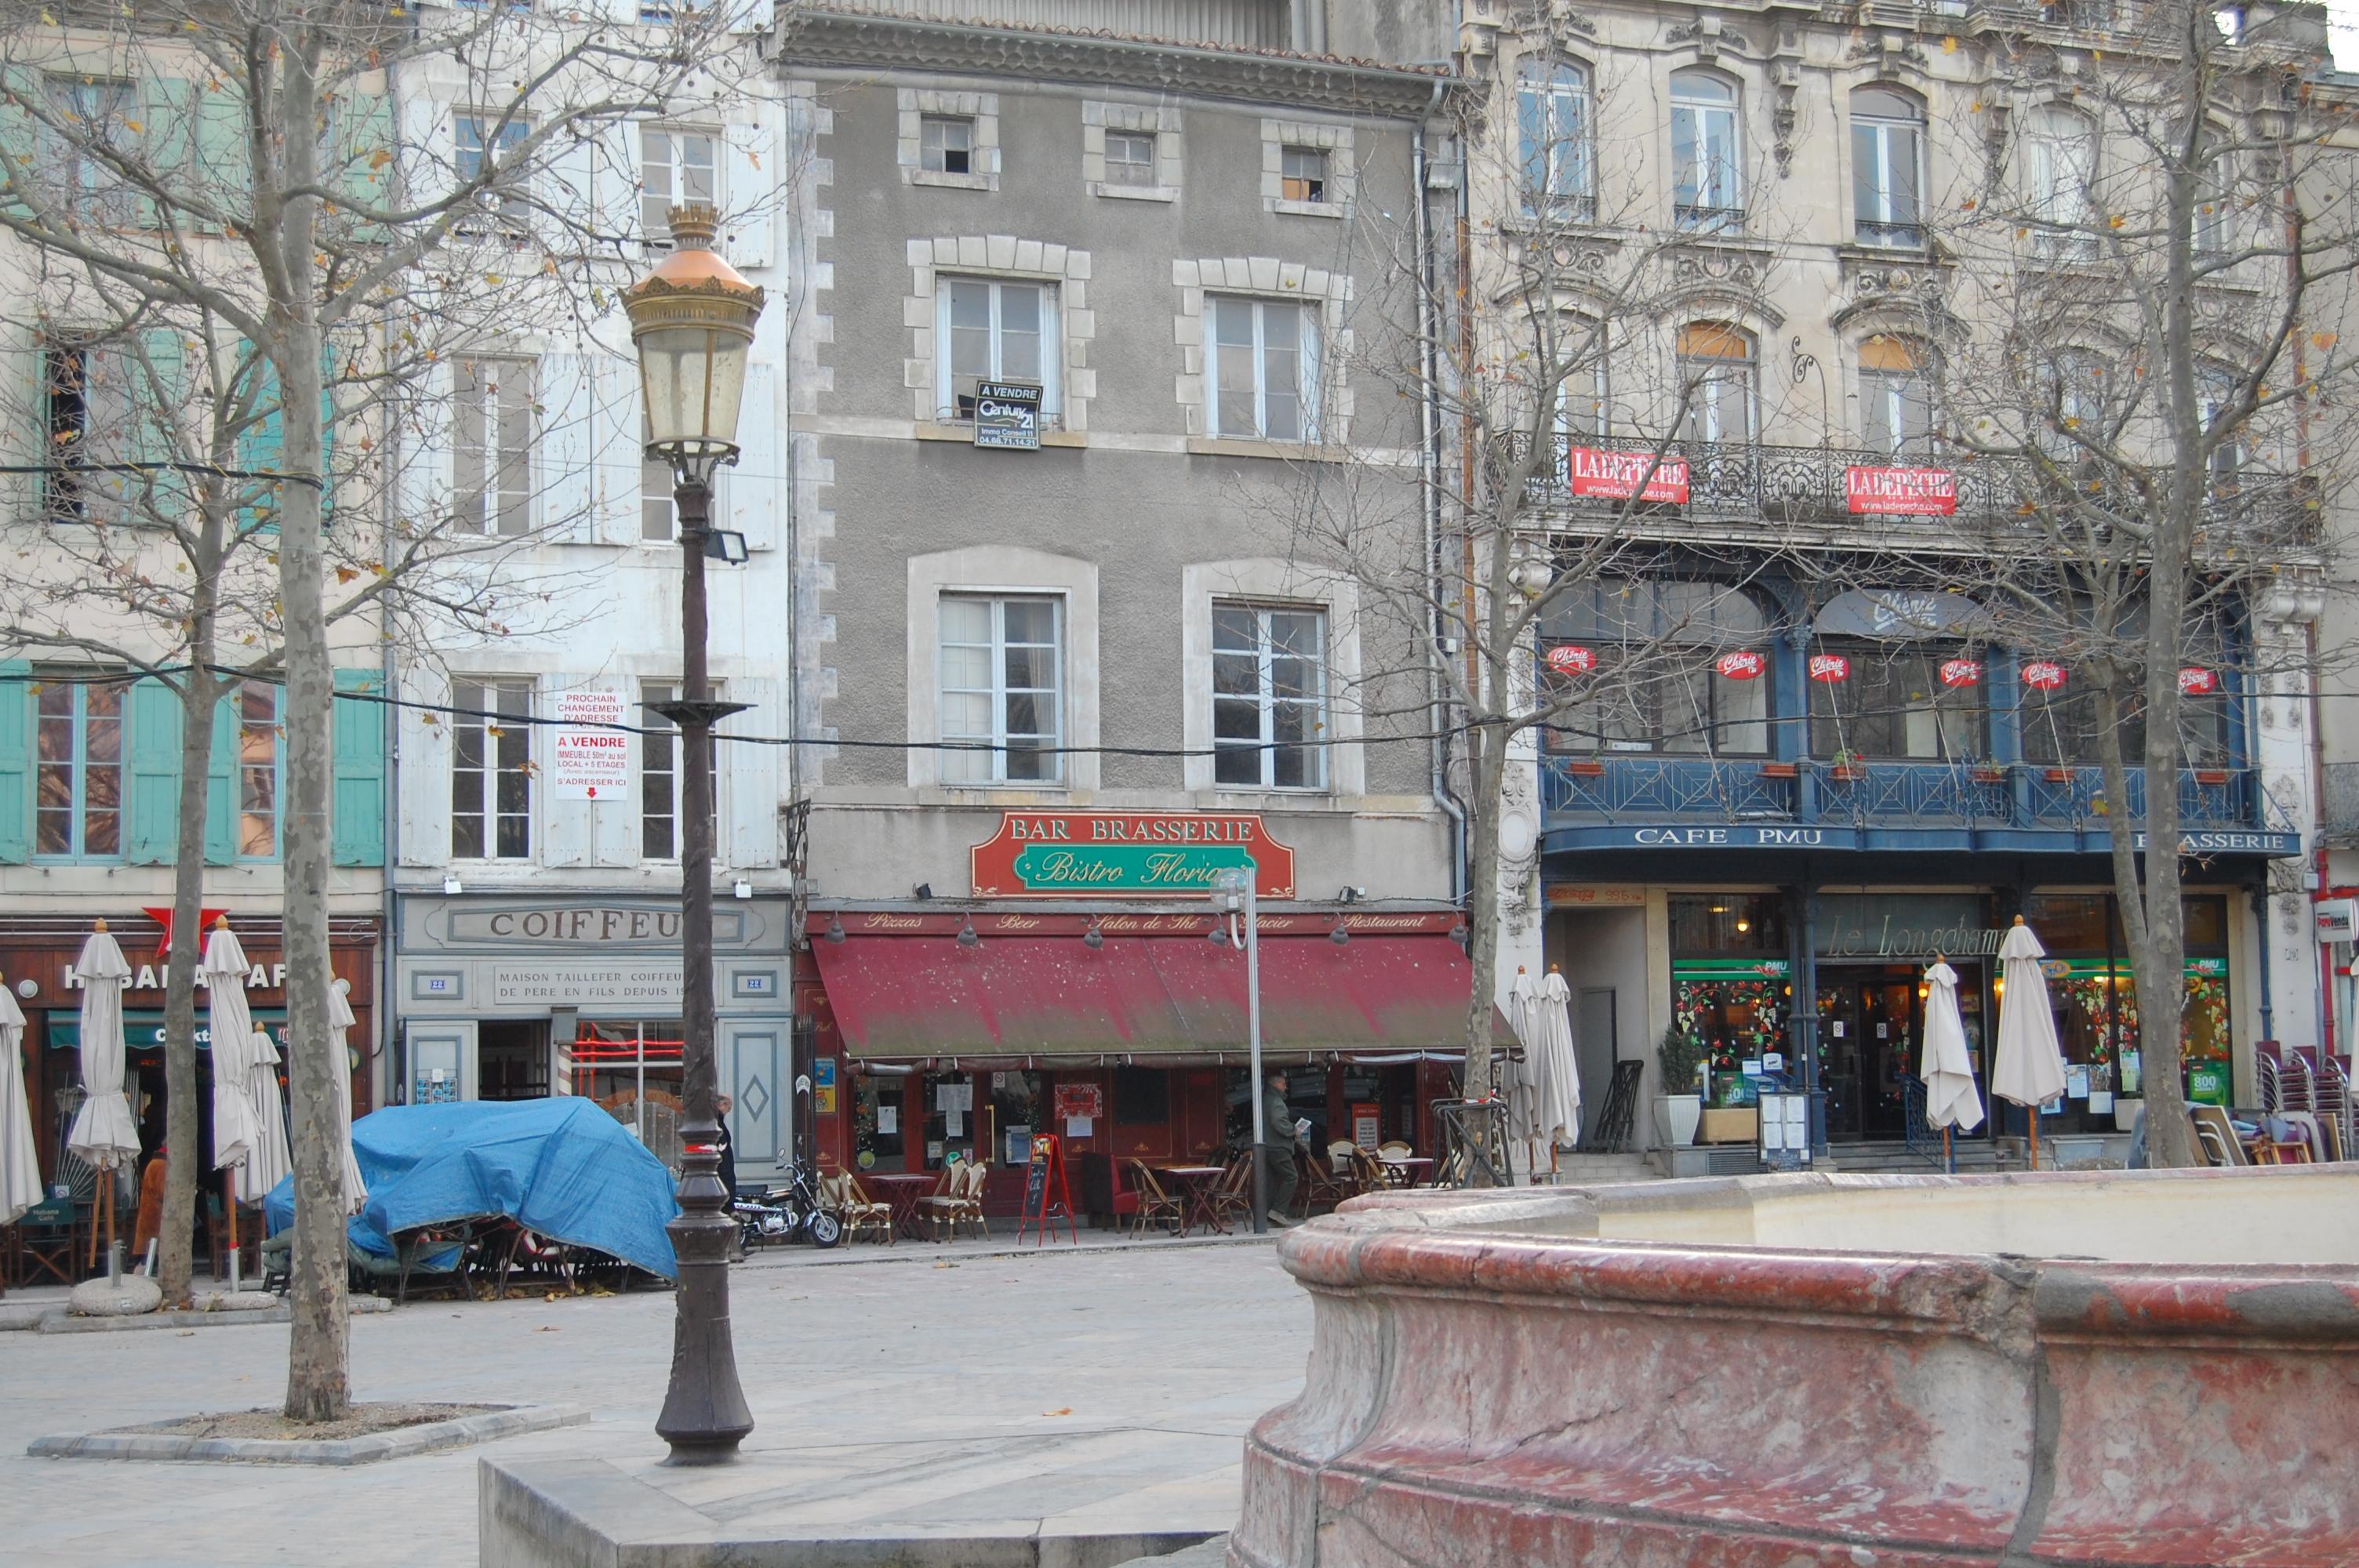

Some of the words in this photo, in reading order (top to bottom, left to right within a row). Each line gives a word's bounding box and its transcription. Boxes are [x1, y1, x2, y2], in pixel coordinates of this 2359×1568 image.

[982, 386, 990, 395] A
[994, 387, 1037, 399] VENDRE
[980, 400, 1027, 419] Century
[1020, 413, 1034, 429] 21
[1575, 452, 1600, 478] LA
[1849, 470, 1872, 495] LA
[1725, 655, 1757, 670] Chérie
[1812, 658, 1845, 673] Chérie
[558, 704, 625, 713] CHANGEMENT
[565, 714, 619, 723] D'ADRESSE
[558, 737, 567, 746] A
[571, 737, 626, 747] VENDRE
[558, 750, 591, 759] IMMEUBLE
[1011, 819, 1070, 840] BAR
[1092, 820, 1254, 841] BRASSERIE
[1634, 829, 1728, 844] CAFE
[1757, 829, 1823, 844] PMU
[2135, 833, 2284, 849] BASSERIE
[1035, 851, 1124, 882] Bistro
[1140, 852, 1221, 882] Floria
[490, 909, 681, 940] COIFFEU
[863, 913, 922, 928] Pizzas
[996, 913, 1041, 929] Beer
[1088, 914, 1139, 930] Salon
[1143, 915, 1161, 929] de
[1168, 915, 1201, 929] Thé
[1343, 913, 1427, 928] Restaurant
[1826, 915, 1862, 957] Le
[1765, 961, 1787, 971] PMU
[2199, 960, 2219, 969] PMU
[65, 964, 210, 989] HBAA
[500, 973, 549, 982] MAISON
[556, 973, 621, 982] TAILLEFER
[749, 979, 759, 988] 22
[500, 988, 516, 996] DE
[525, 988, 556, 996] PERE
[565, 988, 580, 996] EN
[589, 988, 615, 996] FILS
[624, 987, 667, 996] DEPUIS
[2194, 1076, 2216, 1087] 800
